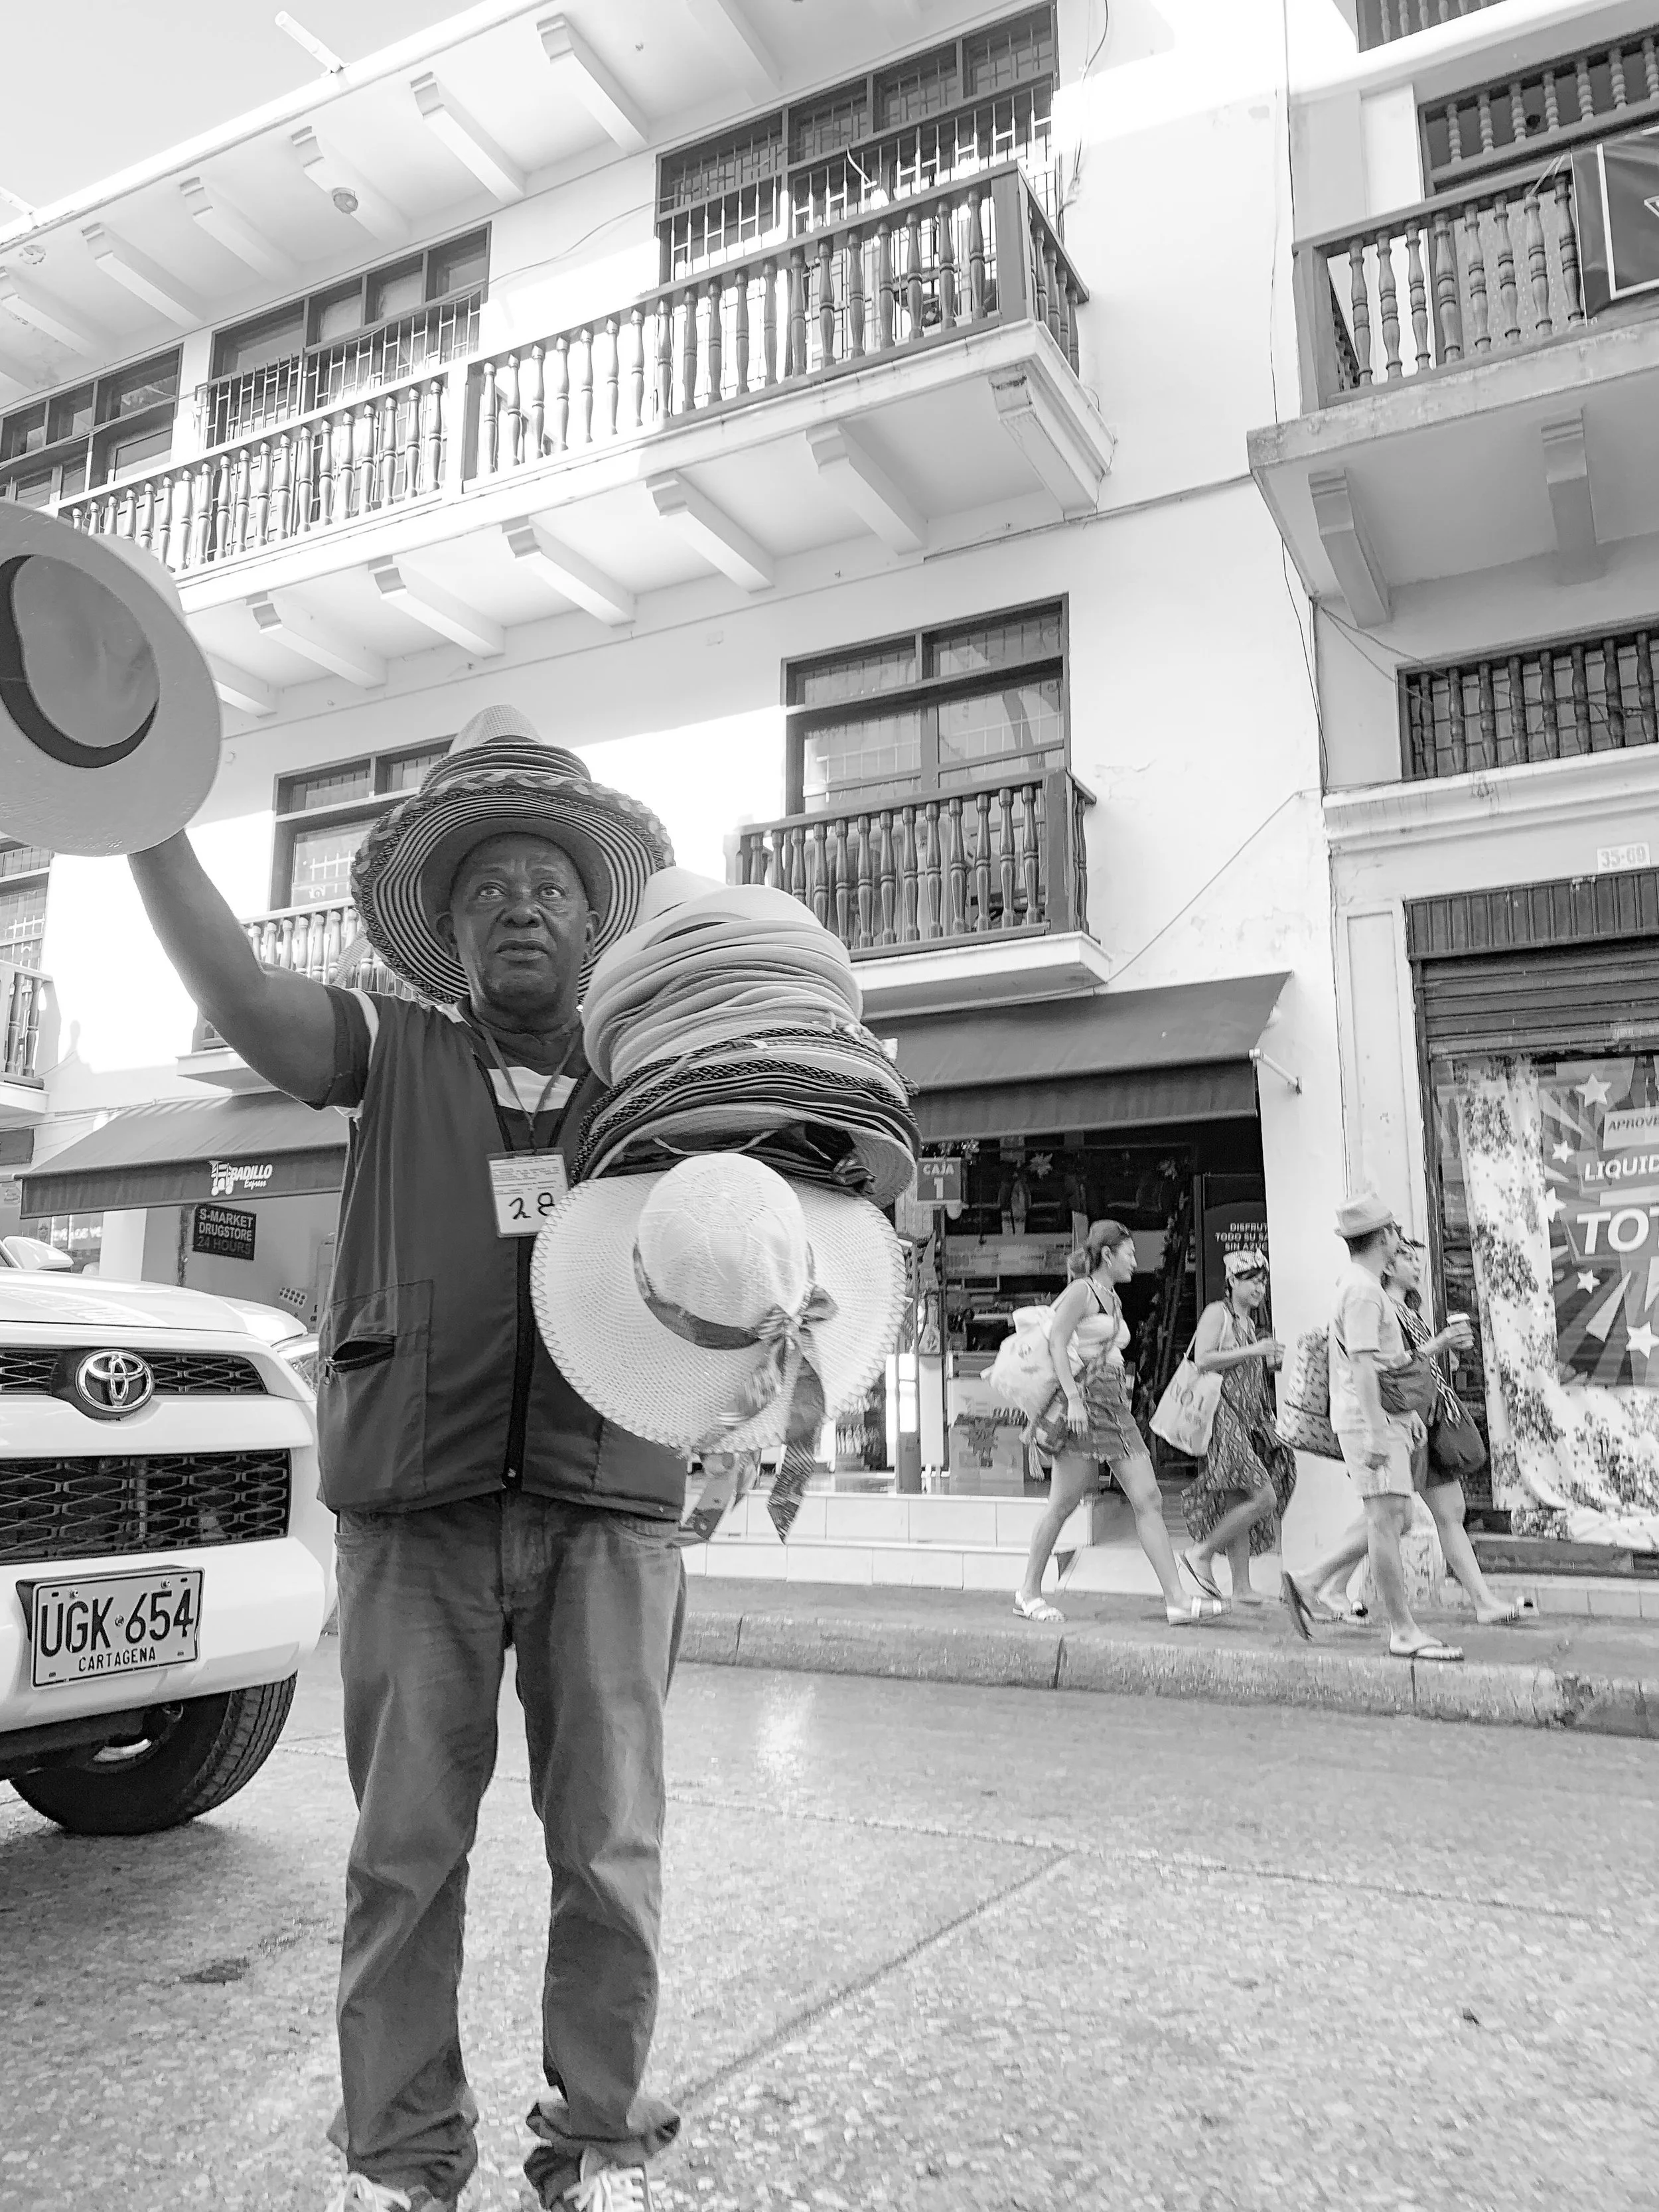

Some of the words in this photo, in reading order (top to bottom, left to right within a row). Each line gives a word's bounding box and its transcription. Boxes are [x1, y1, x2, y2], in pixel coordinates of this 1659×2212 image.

[231, 1164, 273, 1181] BADILLO
[923, 1163, 955, 1175] CAJA
[934, 1177, 944, 1199] 1
[508, 1192, 555, 1219] 28
[199, 1208, 253, 1228] S-MARKET
[199, 1222, 252, 1242] DRUGSTORE
[1214, 1232, 1242, 1242] TODO
[1244, 1232, 1256, 1242] SU
[197, 1236, 210, 1247] 24
[213, 1238, 252, 1254] HOURS
[1224, 1242, 1240, 1252] SIN
[40, 1596, 114, 1657] UGK
[125, 1588, 194, 1644] 654
[78, 1646, 156, 1672] CARTAGENA
